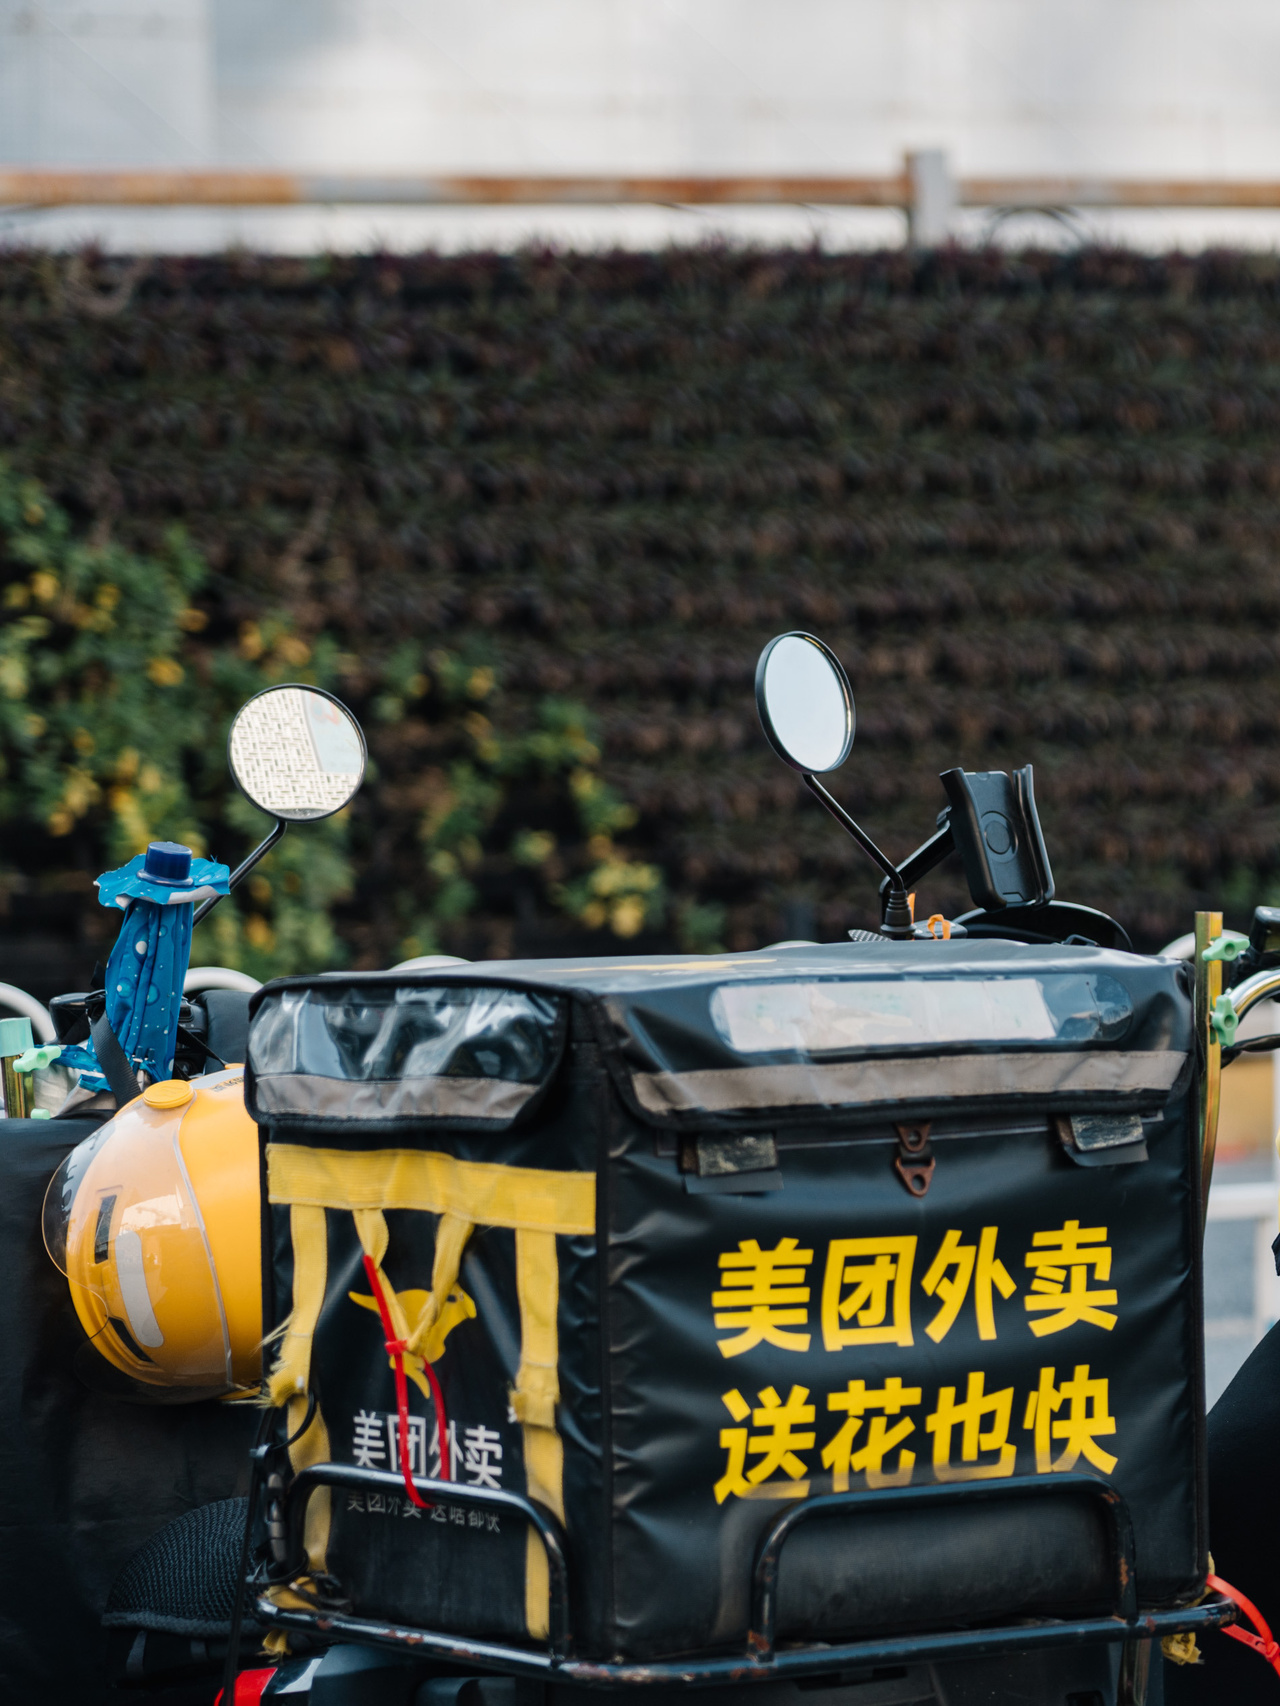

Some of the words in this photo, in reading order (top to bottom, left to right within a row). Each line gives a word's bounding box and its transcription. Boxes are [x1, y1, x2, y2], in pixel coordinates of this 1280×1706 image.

[711, 1219, 1119, 1359] 美团外卖
[352, 1408, 503, 1490] 美团外卖
[713, 1364, 1119, 1506] 送花也快
